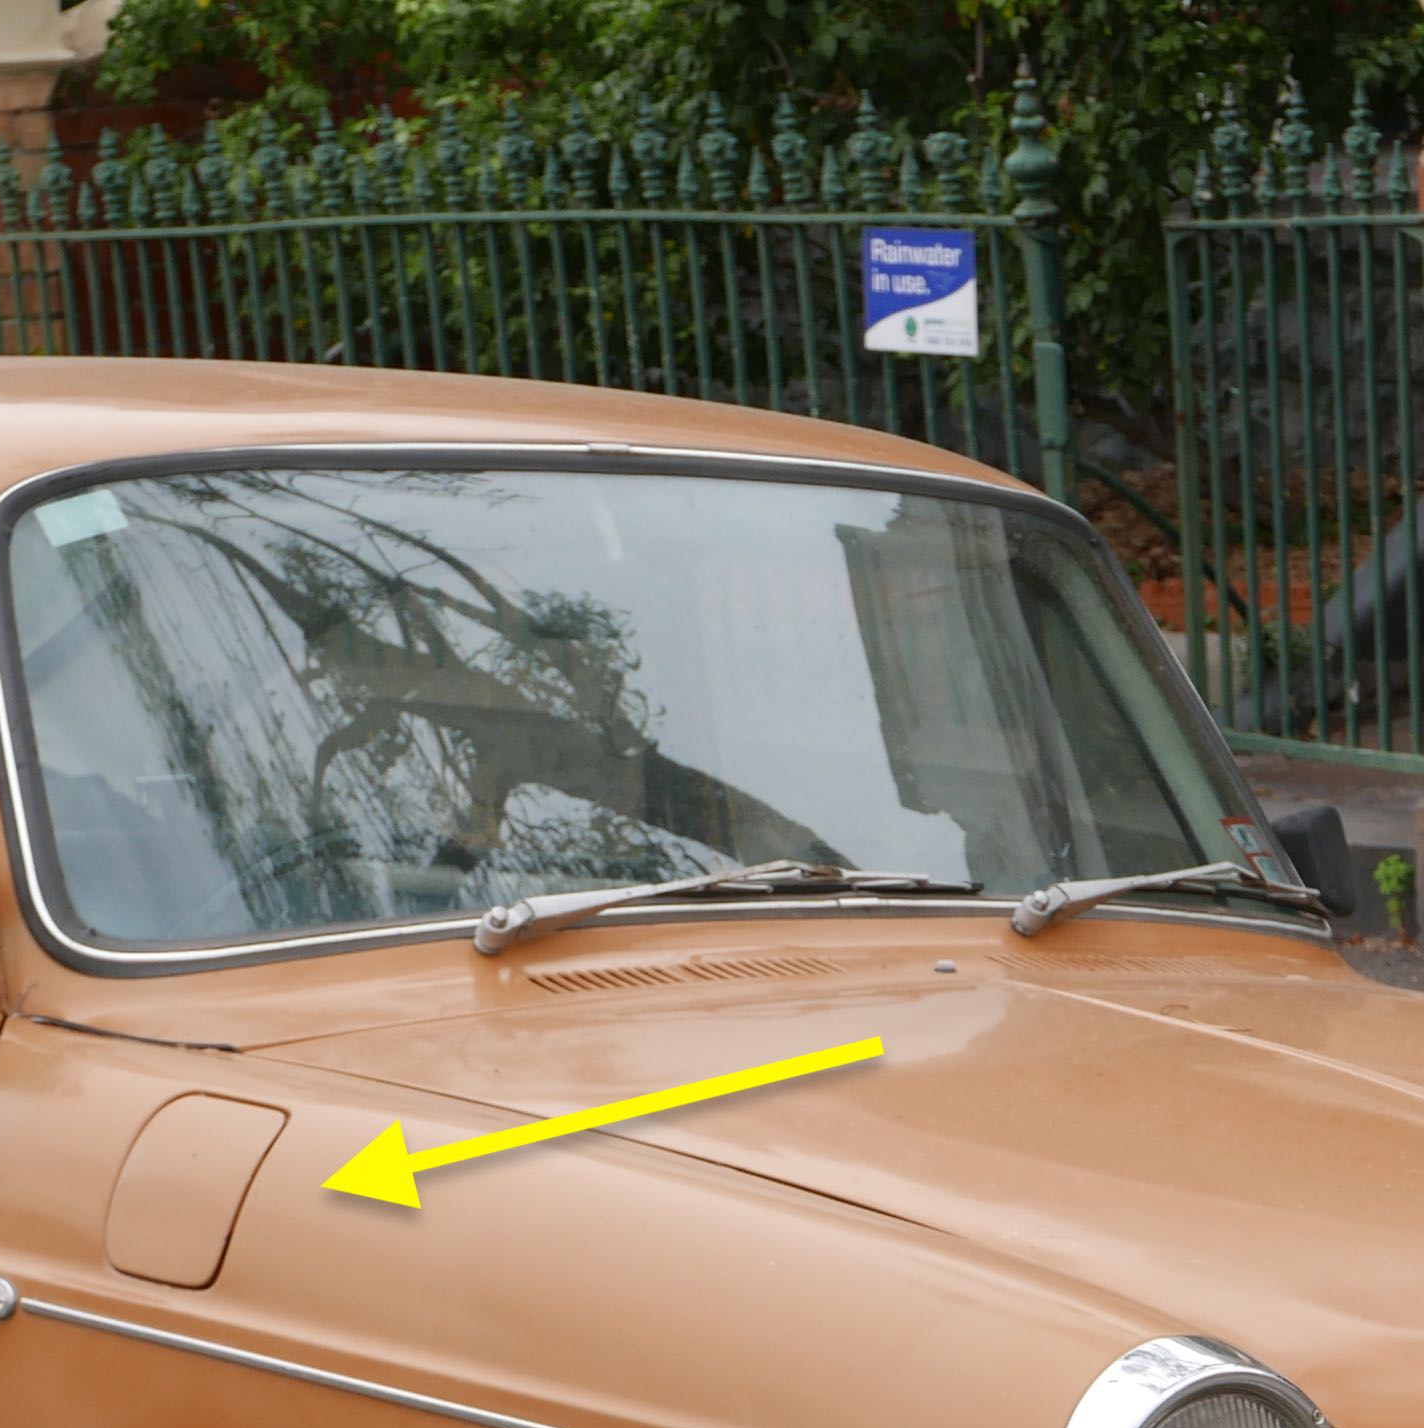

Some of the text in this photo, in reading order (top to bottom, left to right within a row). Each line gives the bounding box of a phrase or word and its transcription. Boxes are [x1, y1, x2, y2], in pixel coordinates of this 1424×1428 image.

[870, 238, 962, 268] Rainwater
[871, 267, 931, 295] in use.
